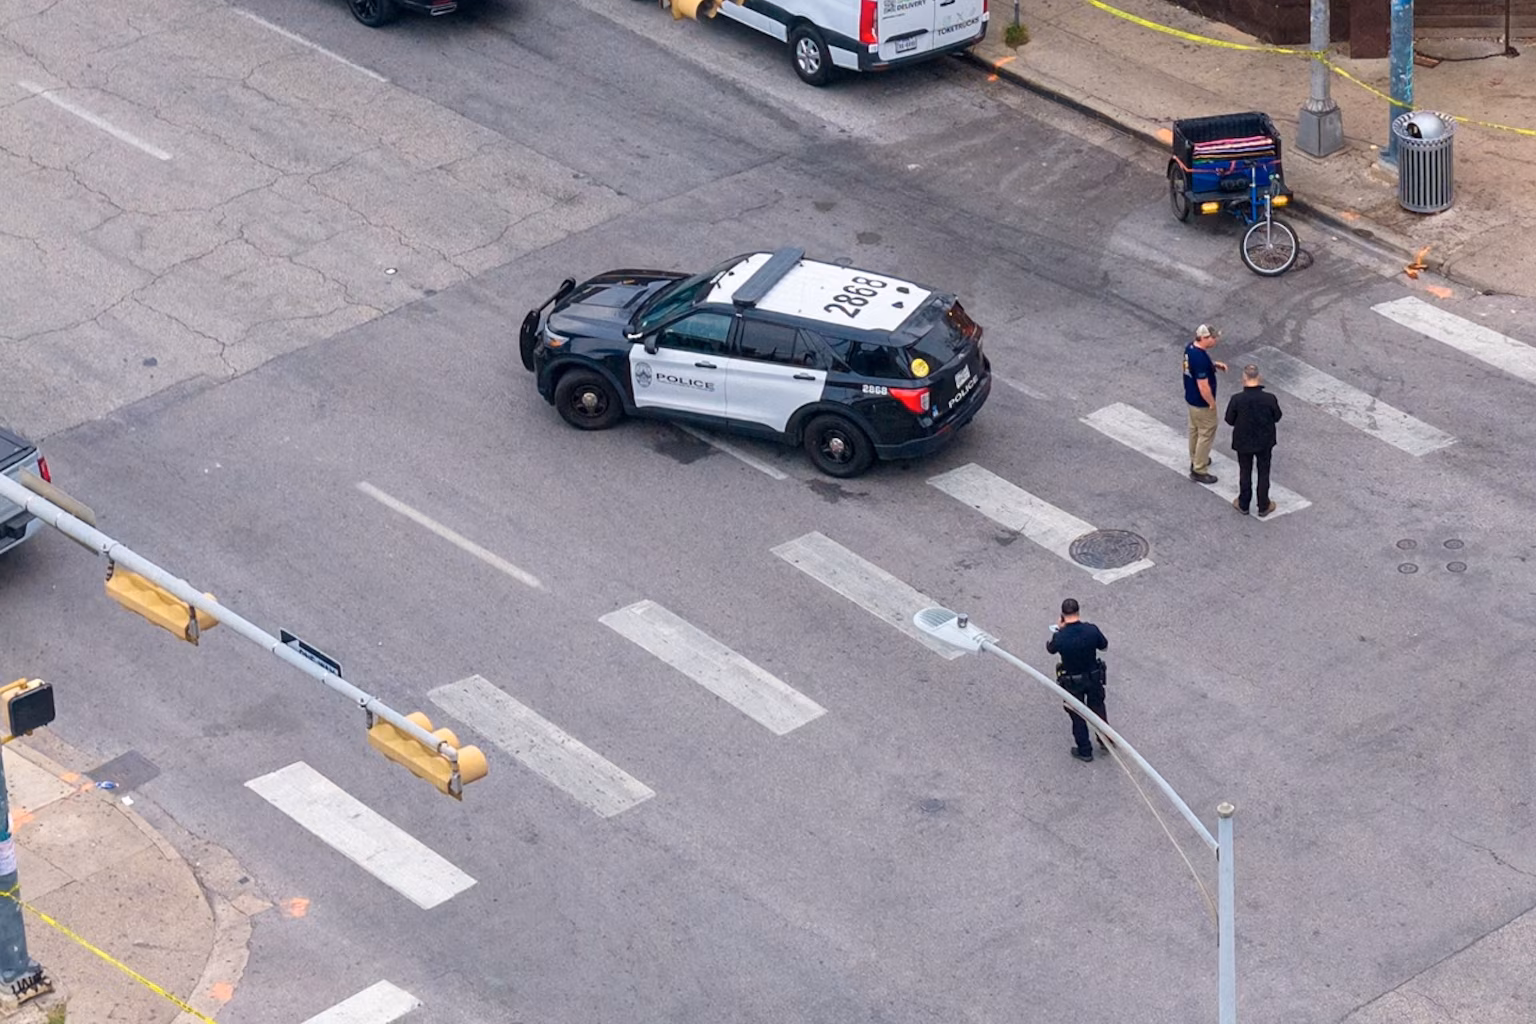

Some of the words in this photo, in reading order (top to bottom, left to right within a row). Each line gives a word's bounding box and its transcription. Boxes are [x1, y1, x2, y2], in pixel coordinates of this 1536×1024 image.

[896, 0, 927, 11] DELIVERY
[824, 276, 888, 319] 2868
[656, 373, 715, 389] POLICE
[862, 384, 888, 395] 2868
[948, 375, 979, 409] POLICE
